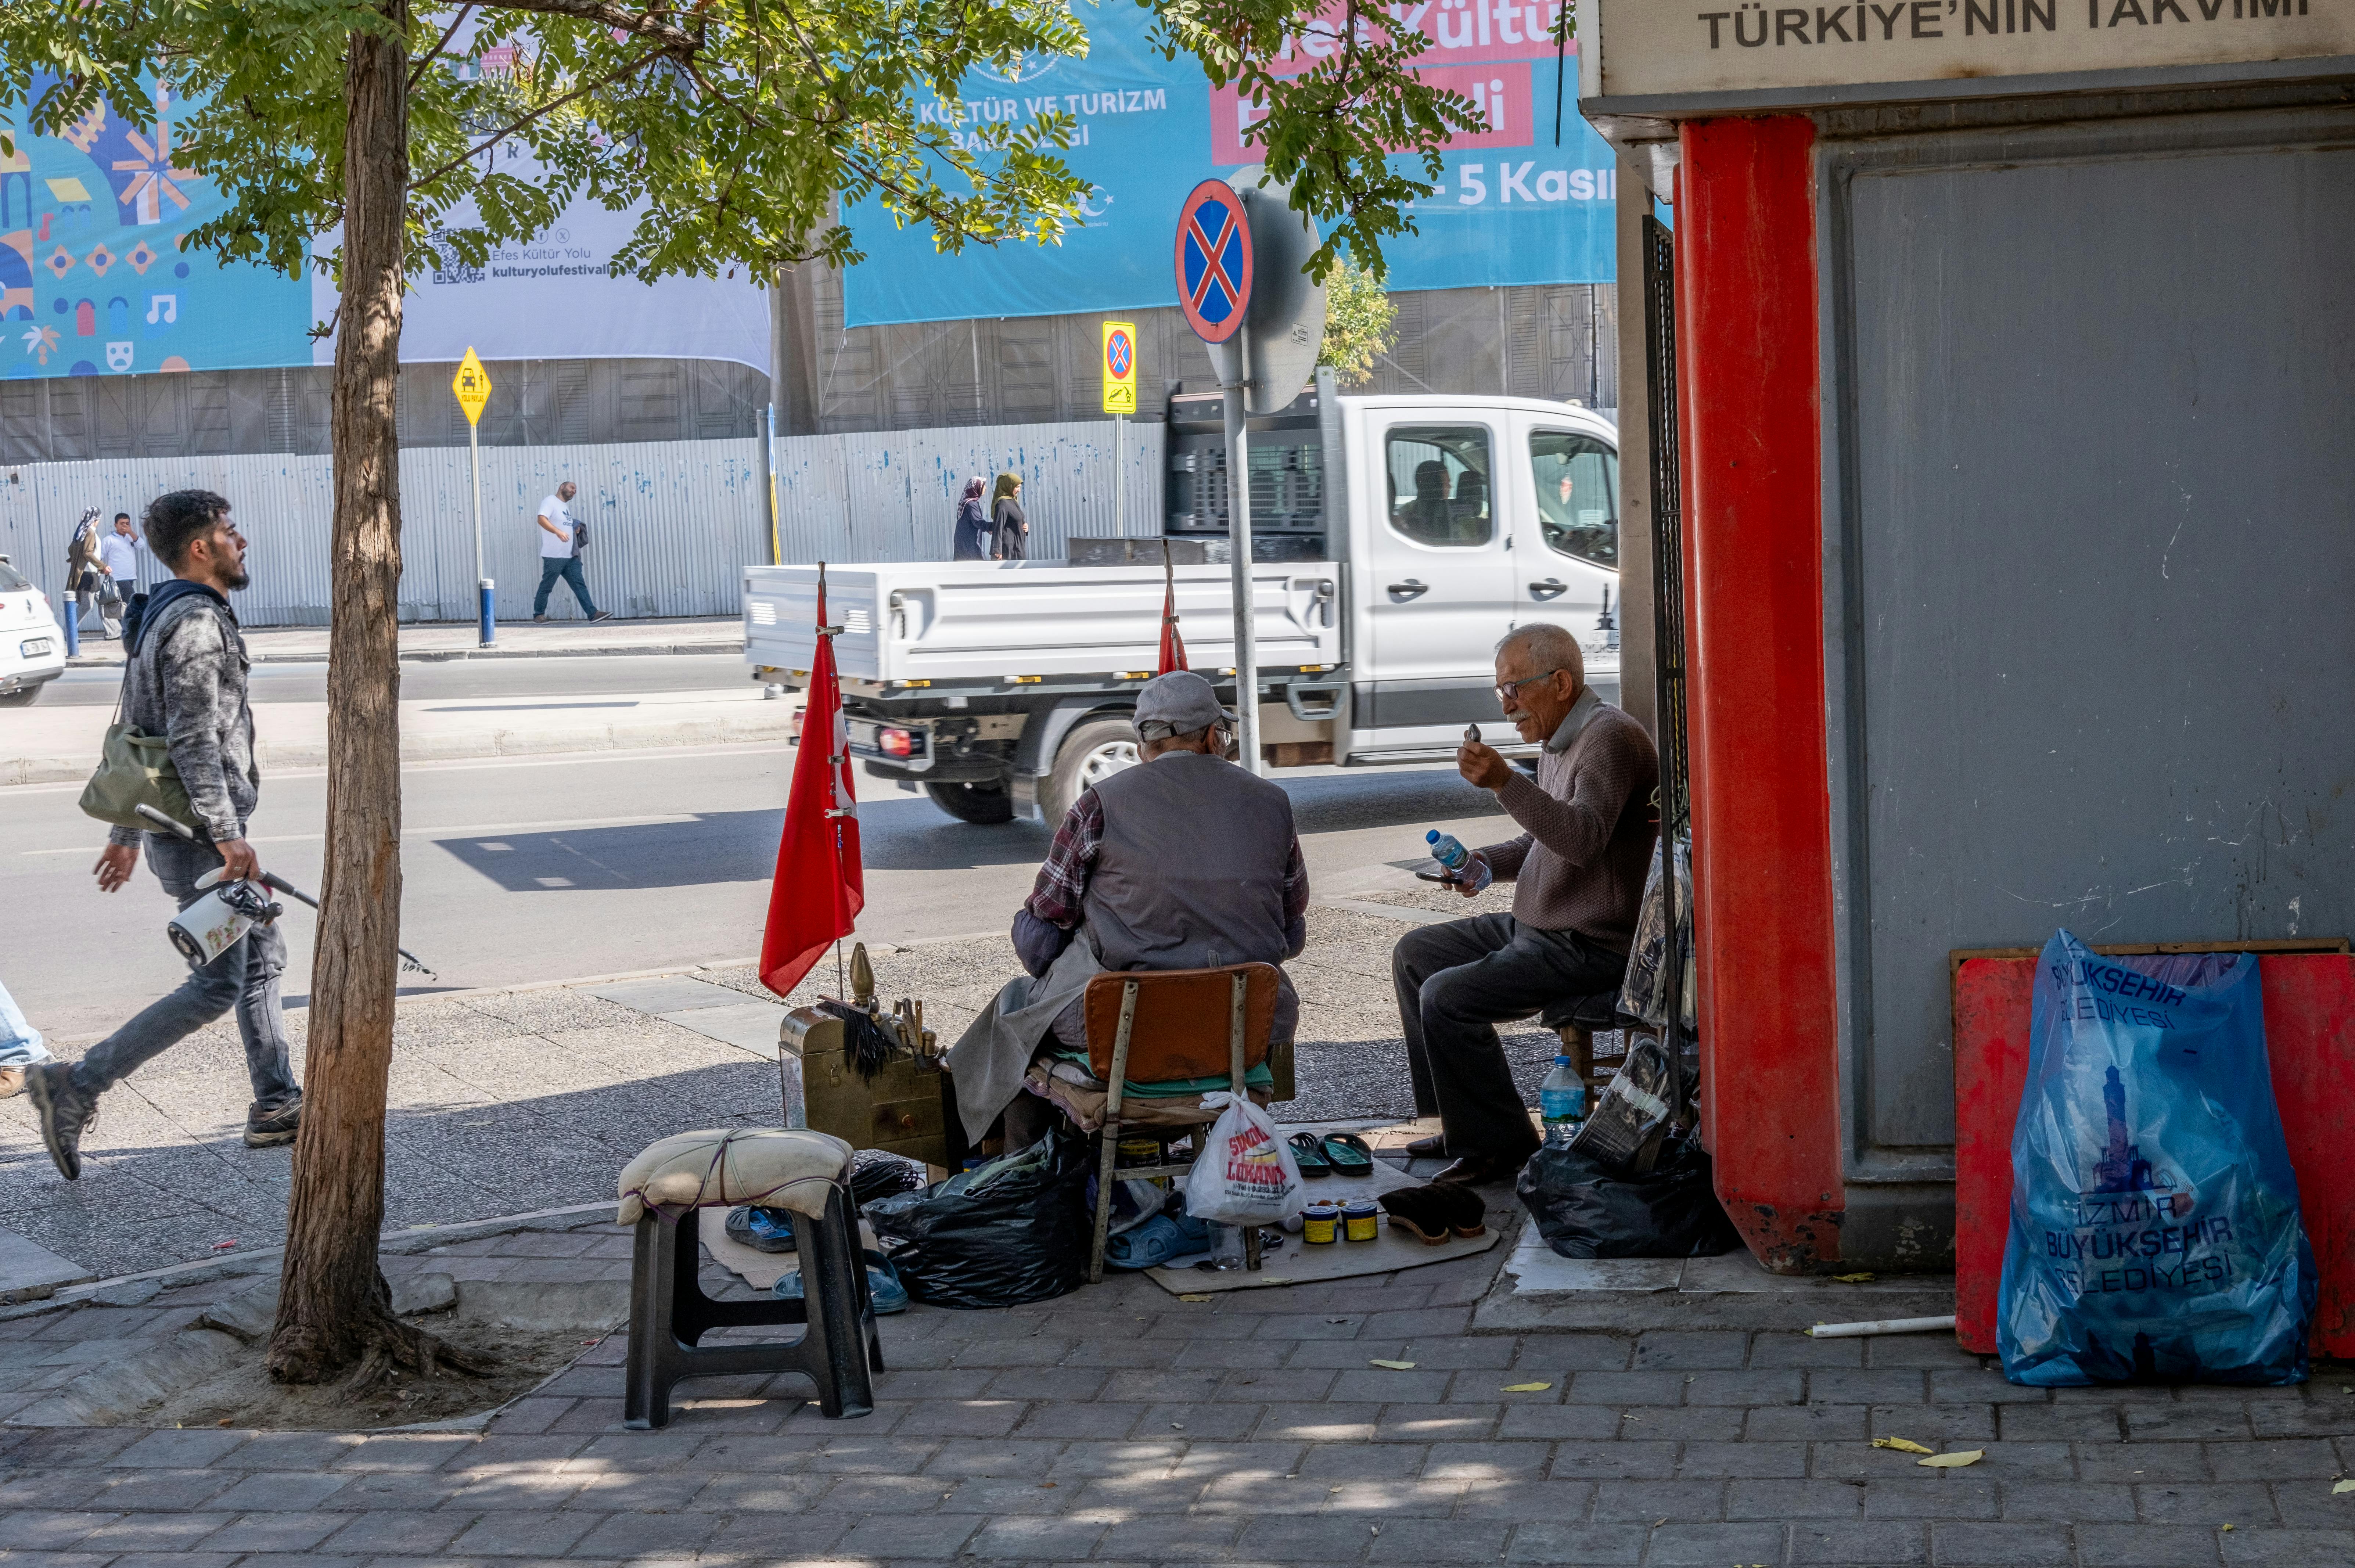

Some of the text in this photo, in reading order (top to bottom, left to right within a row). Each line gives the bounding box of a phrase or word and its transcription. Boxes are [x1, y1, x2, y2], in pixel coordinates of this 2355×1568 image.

[1025, 96, 1056, 119] VE
[1065, 89, 1166, 115] TURİZM
[1459, 164, 1486, 205] 5
[1500, 161, 1616, 203] Kası
[493, 248, 590, 261] Efes Kültür Yolu
[2077, 1195, 2177, 1225] İZMİR
[2046, 1214, 2233, 1260] BÜYÜKŞEHİR
